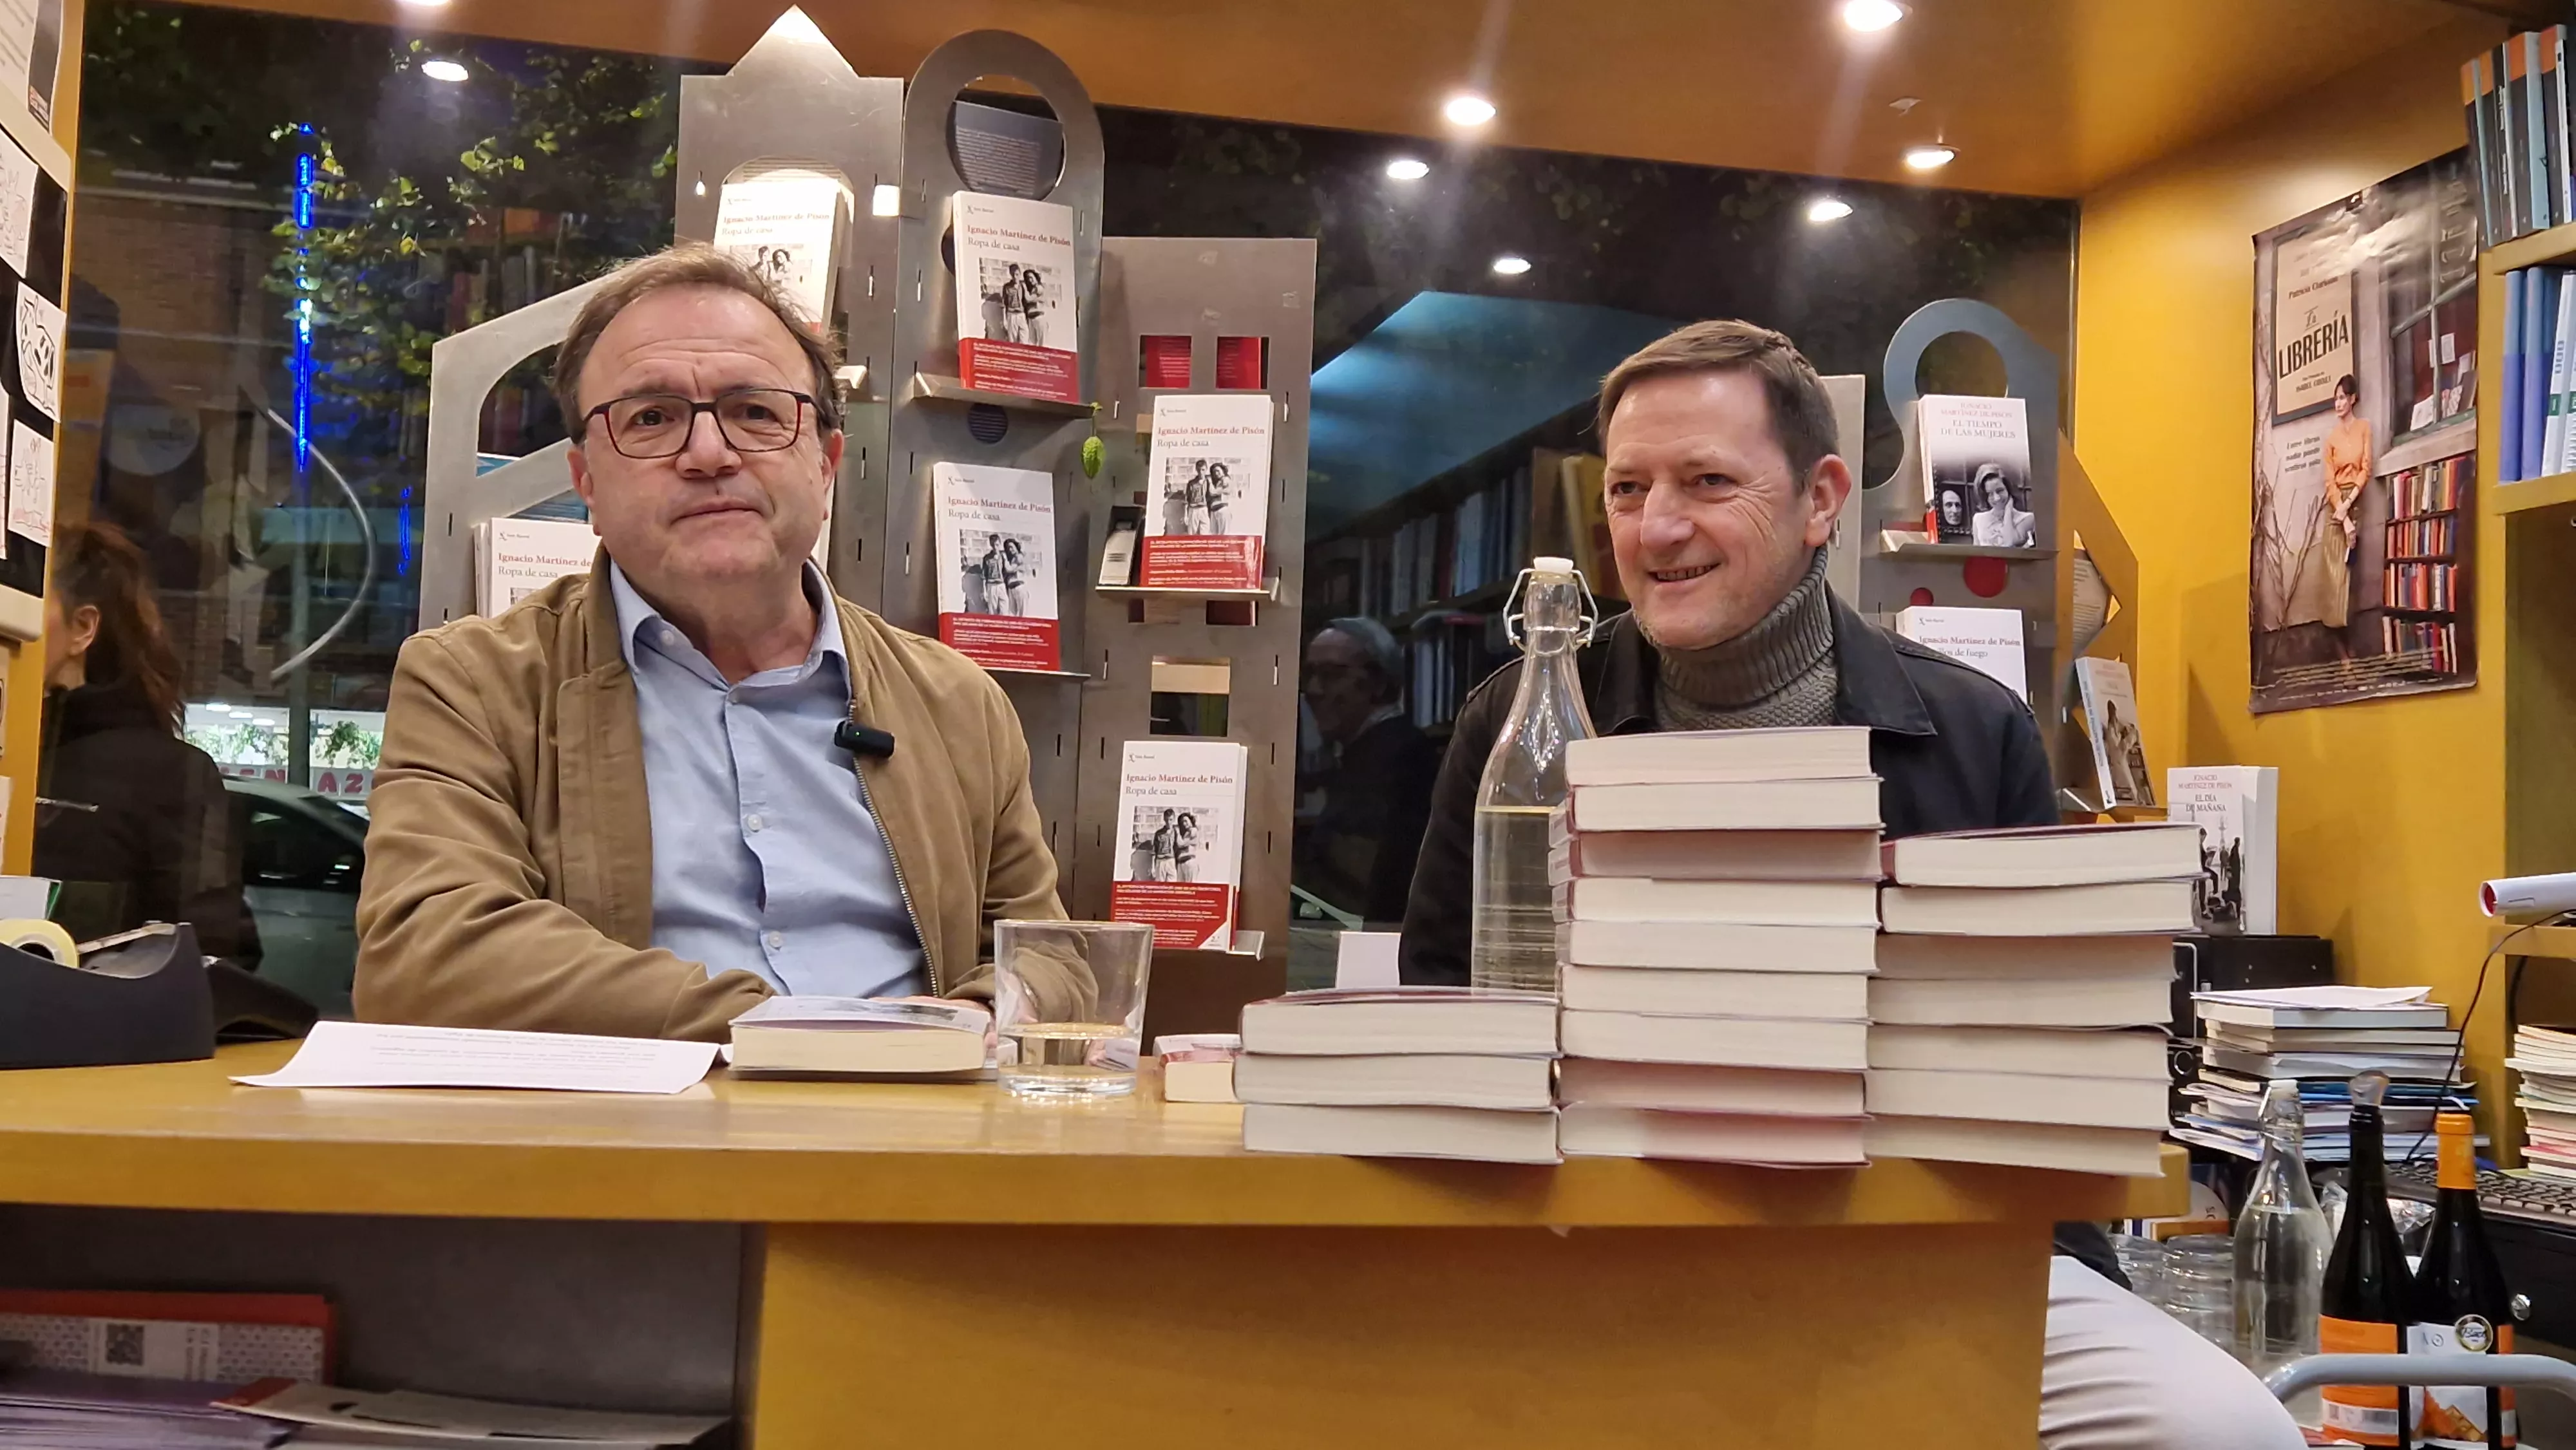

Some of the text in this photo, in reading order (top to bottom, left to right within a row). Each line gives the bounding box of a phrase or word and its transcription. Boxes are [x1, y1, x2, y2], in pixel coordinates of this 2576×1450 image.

[723, 216, 753, 225] Ignacio
[721, 227, 742, 236] Ropa
[744, 227, 753, 235] de
[967, 225, 998, 236] Ignacio
[1039, 234, 1048, 243] de
[968, 237, 989, 249] Ropa
[991, 240, 1001, 249] de
[2278, 310, 2349, 379] LIBRERÍA
[1967, 420, 2002, 428] TIEMPO
[1157, 426, 1188, 437] Ignacio
[1941, 428, 1952, 436] DE
[1974, 430, 2016, 438] MUJERES
[1157, 439, 1177, 449] Ropa
[1180, 438, 1189, 447] de
[948, 496, 978, 506] Ignacio
[1018, 503, 1028, 512] de
[948, 509, 969, 520] Ropa
[971, 510, 981, 519] de
[498, 552, 592, 567] Ignacio Martínez de
[498, 566, 523, 578] Ropa
[525, 567, 536, 577] de
[1919, 636, 1948, 644] Ignacio
[1955, 646, 1965, 656] de
[1966, 648, 1988, 659] fuego
[317, 771, 376, 793] AZ
[1126, 773, 1233, 784] Ignacio Martínez de Pisón
[1126, 786, 1146, 797] Ropa
[1148, 786, 1158, 795] de
[2186, 803, 2226, 812] DE MAÑANA
